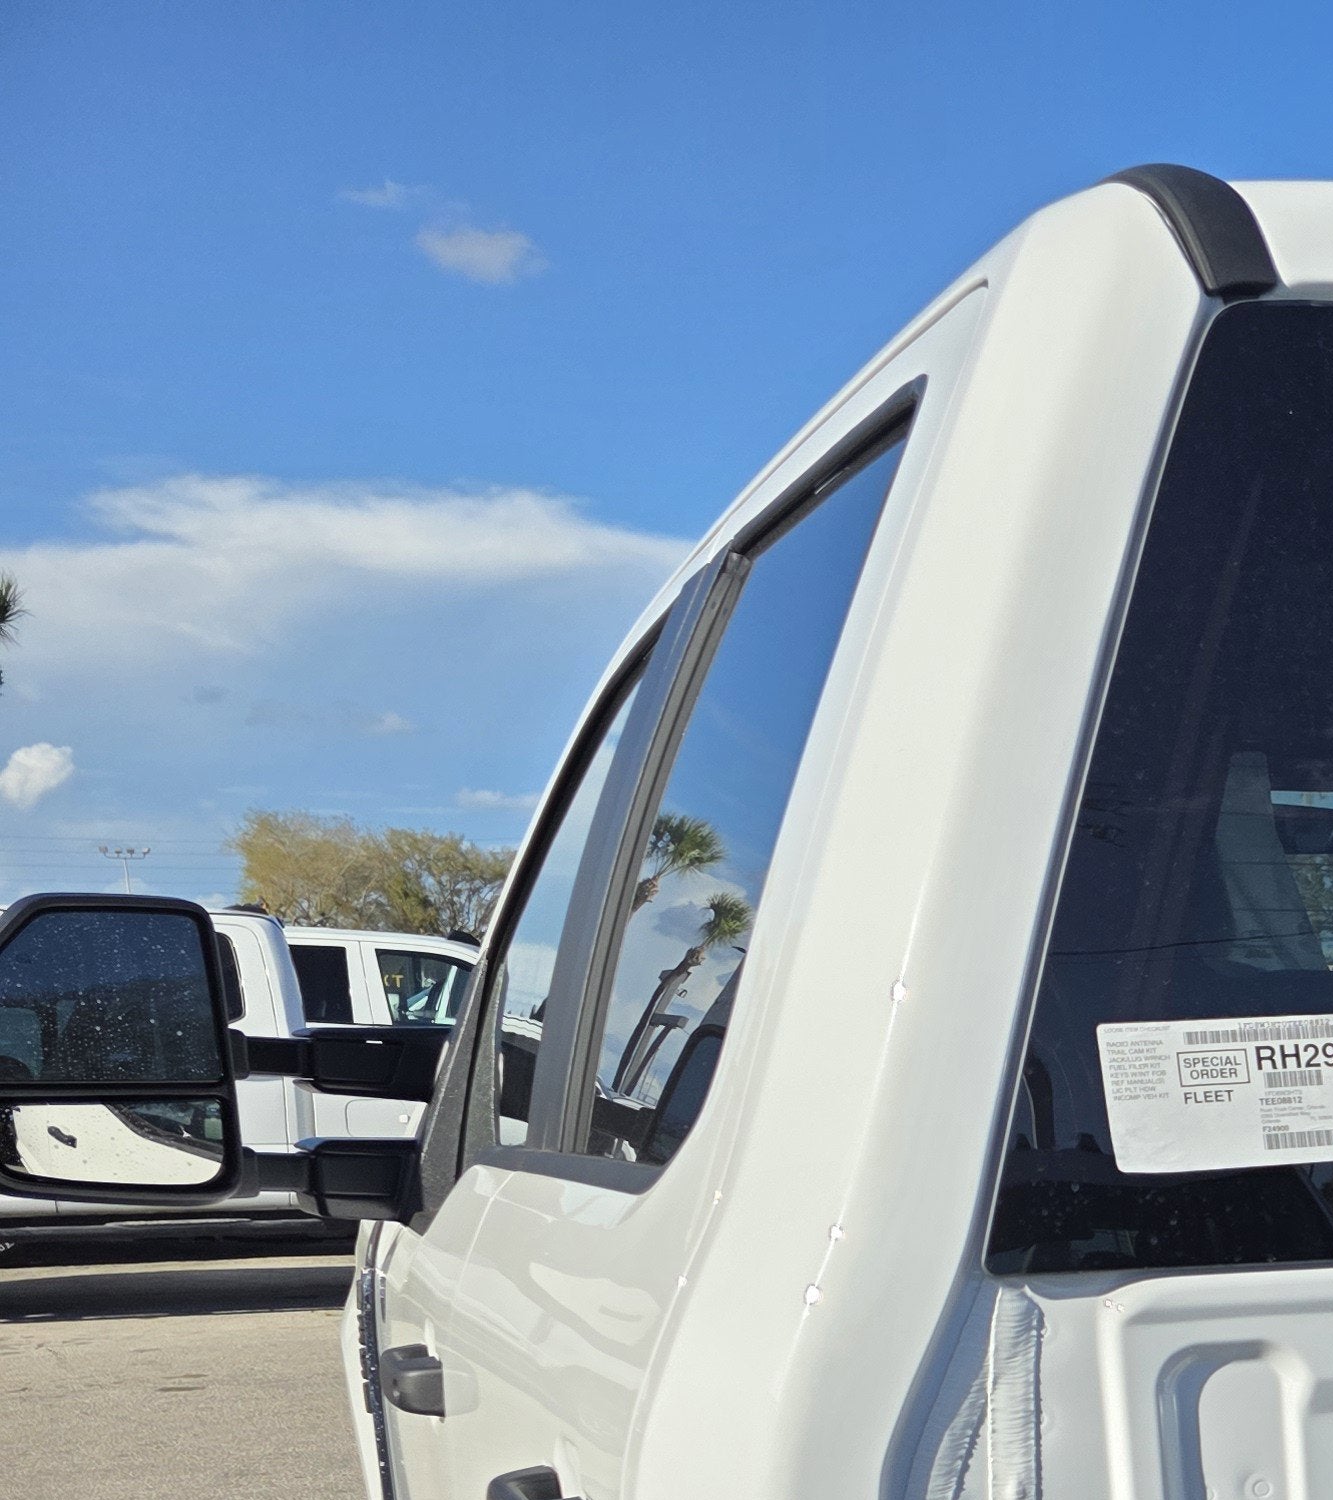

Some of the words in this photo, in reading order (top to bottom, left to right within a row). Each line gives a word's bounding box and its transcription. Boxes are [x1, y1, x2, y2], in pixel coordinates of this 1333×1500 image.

[1183, 1055, 1242, 1069] SPECIAL
[1110, 1071, 1129, 1079] KEYS
[1152, 1069, 1167, 1077] FOB
[1190, 1067, 1239, 1080] ORDER
[1183, 1089, 1234, 1104] FLEET
[1259, 1096, 1303, 1106] TEE08812
